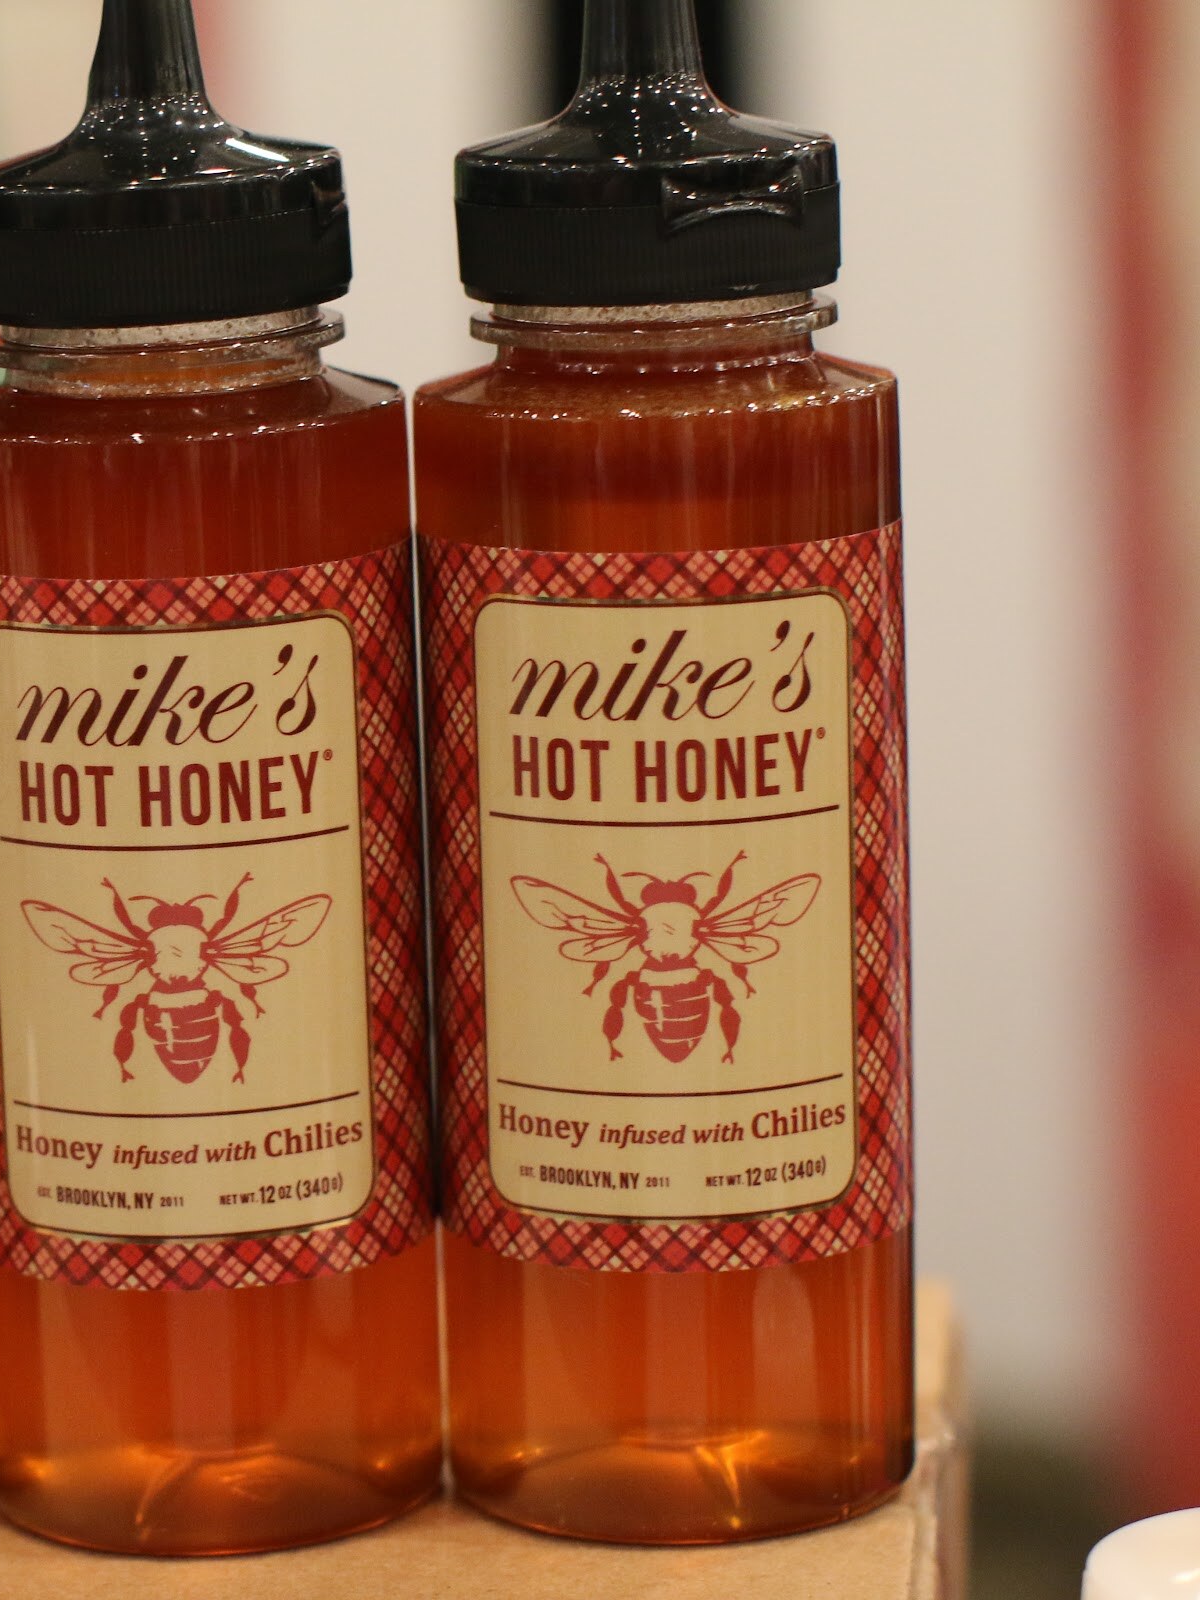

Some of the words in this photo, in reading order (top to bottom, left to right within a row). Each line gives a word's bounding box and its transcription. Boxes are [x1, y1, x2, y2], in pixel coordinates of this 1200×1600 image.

[509, 620, 814, 721] mike's
[16, 644, 319, 747] mike's
[512, 734, 609, 802] HOT
[19, 760, 114, 827] HOT
[16, 1124, 103, 1169] Honey
[113, 1144, 199, 1169] infused
[205, 1141, 256, 1163] with
[264, 1121, 363, 1157] Chilies
[499, 1103, 589, 1148] Honey
[599, 1123, 686, 1149] infused
[693, 1122, 744, 1143] with
[751, 1103, 846, 1139] Chilies
[56, 1185, 131, 1210] BROOKLYN,
[134, 1192, 154, 1209] NY
[160, 1196, 184, 1207] 2011
[219, 1194, 237, 1205] NET
[259, 1185, 275, 1204] 12
[278, 1185, 292, 1200] OZ
[539, 1164, 616, 1190] BROOKLYN,
[619, 1172, 639, 1189] NY
[645, 1176, 670, 1187] 2011
[705, 1175, 724, 1187] NET
[745, 1167, 761, 1186] 12
[764, 1167, 777, 1182] OZ
